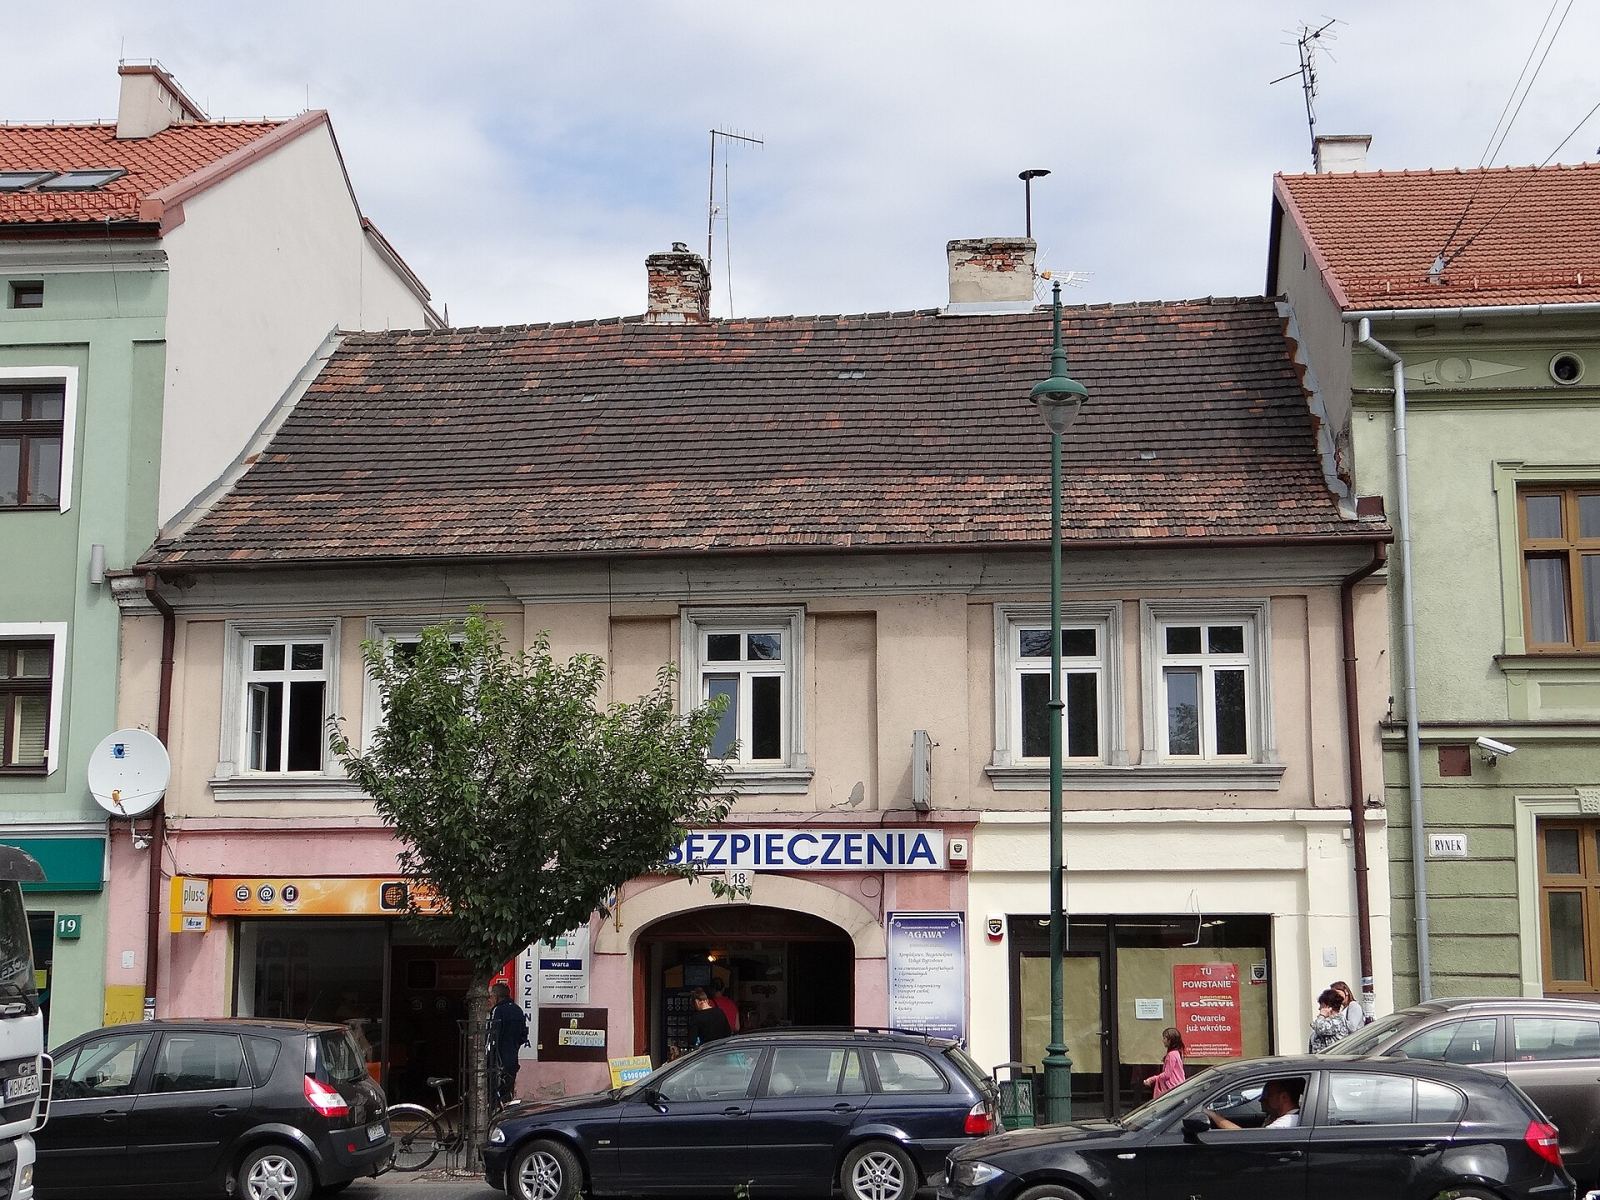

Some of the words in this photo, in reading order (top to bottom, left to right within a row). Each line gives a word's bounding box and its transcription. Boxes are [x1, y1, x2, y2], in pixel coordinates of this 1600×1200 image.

[1434, 839, 1462, 851] RYNEK
[732, 873, 746, 884] 18
[59, 919, 77, 933] 19
[904, 931, 946, 939] "AGAWA"
[1200, 967, 1212, 975] TU
[1182, 980, 1232, 988] POWSTANIE
[1191, 1014, 1226, 1022] Otwarcie
[1186, 1024, 1199, 1033] już
[1200, 1024, 1232, 1032] wkrótce
[18, 1061, 36, 1076] CF
